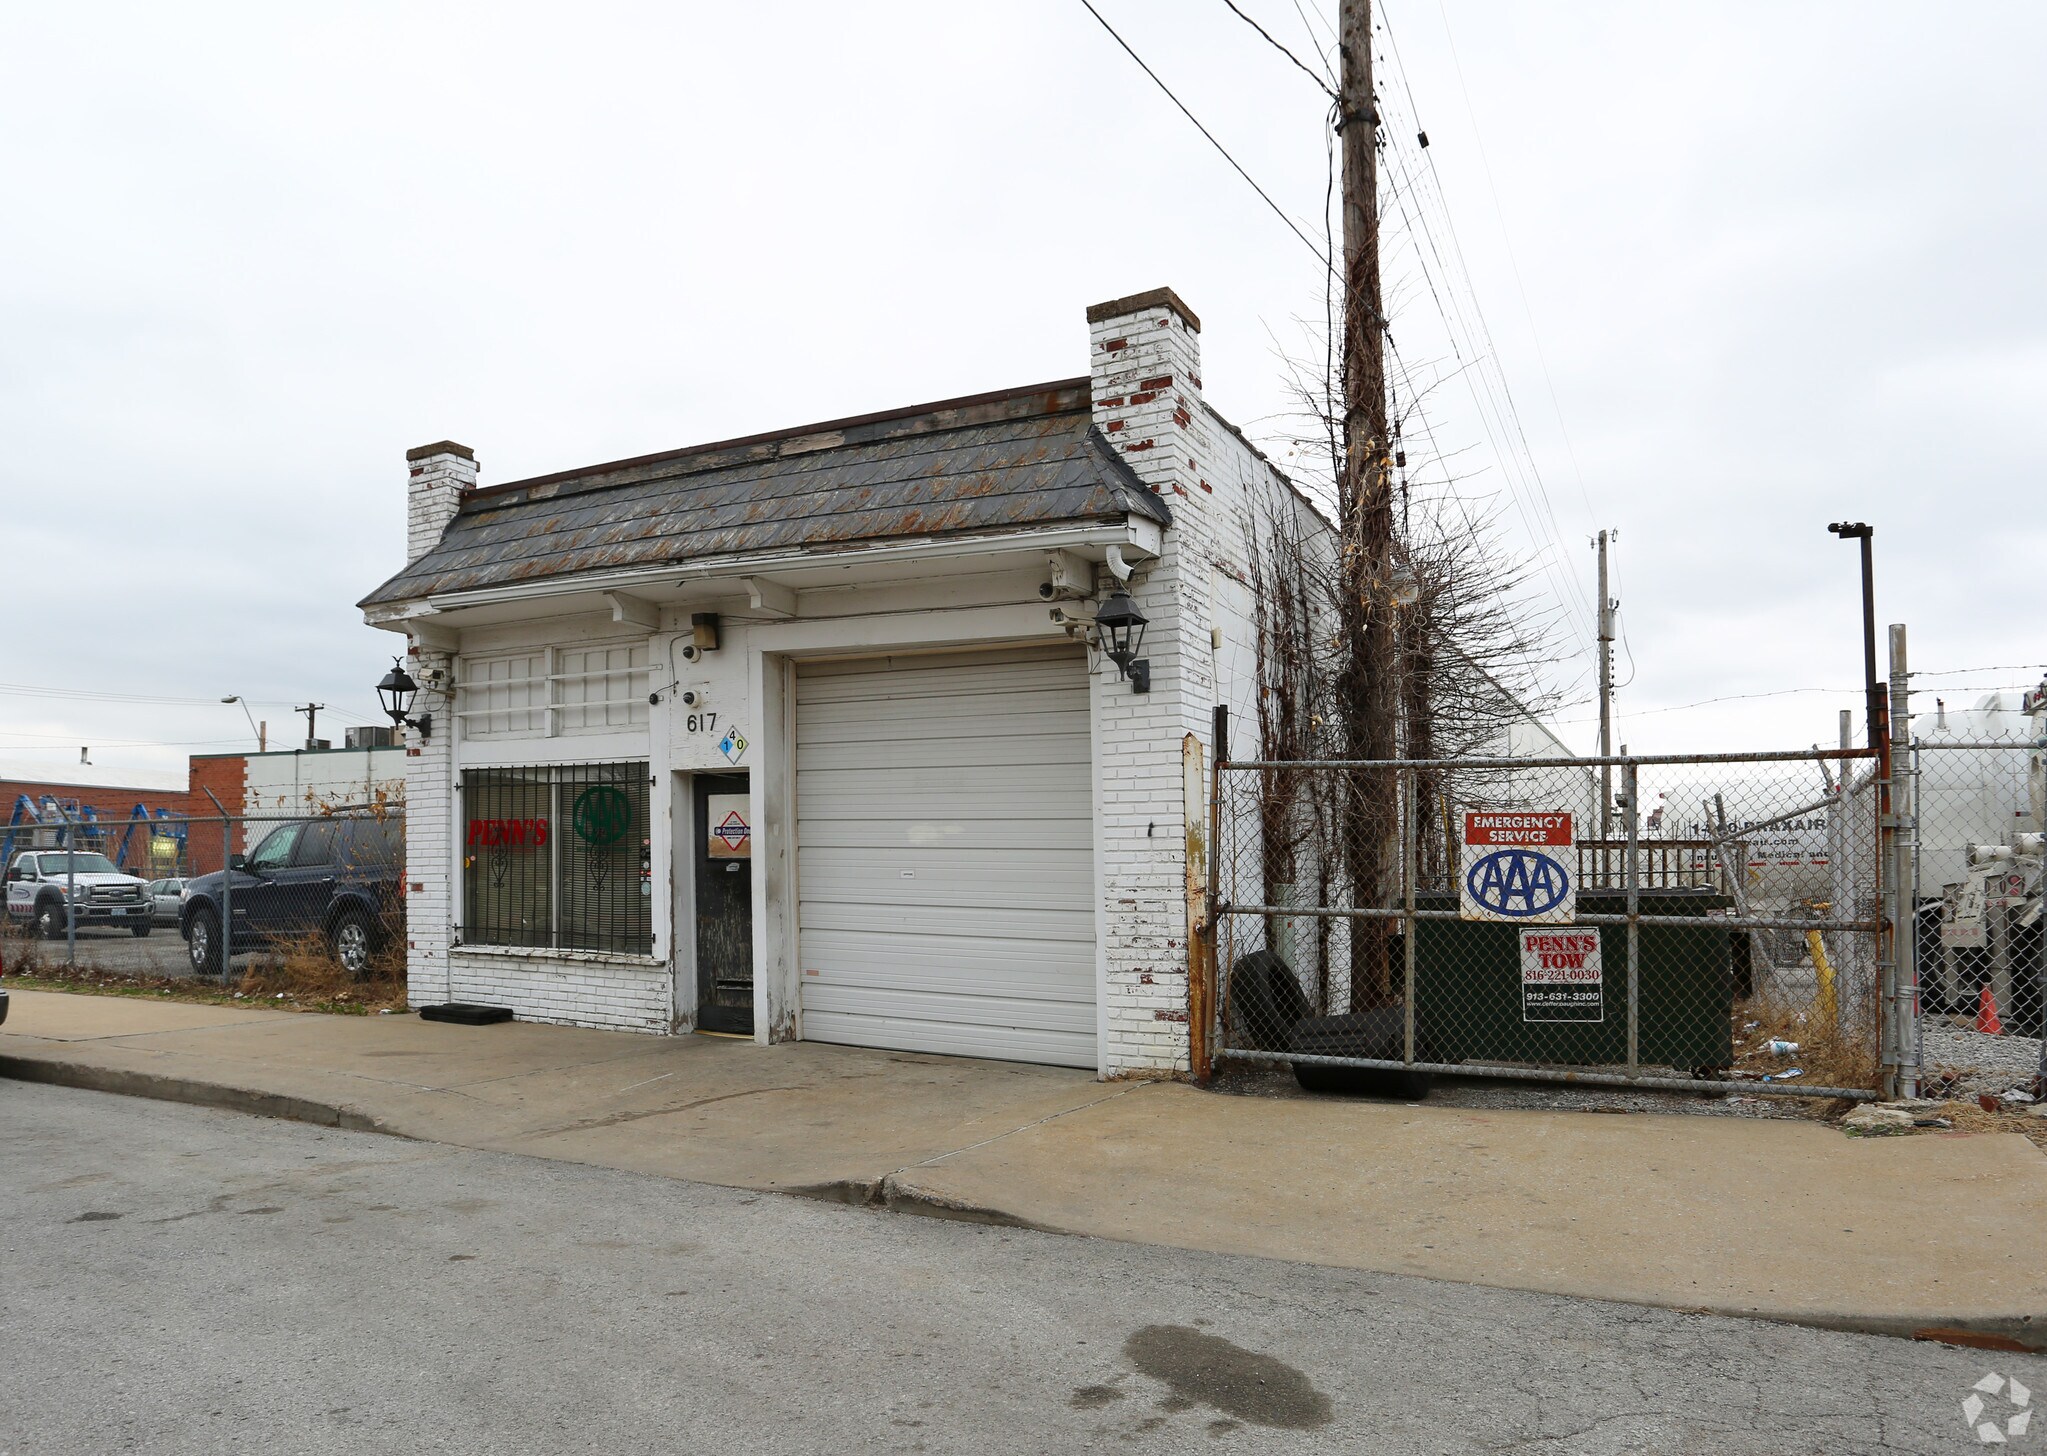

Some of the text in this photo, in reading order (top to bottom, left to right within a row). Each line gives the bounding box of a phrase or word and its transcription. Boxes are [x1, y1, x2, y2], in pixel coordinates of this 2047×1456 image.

[687, 713, 717, 732] 617
[729, 730, 736, 741] 4
[723, 741, 729, 751] 1
[736, 739, 744, 750] 0
[1473, 816, 1564, 829] EMERGENCY
[467, 819, 549, 846] PENN'S
[1489, 831, 1548, 842] SERVICE
[1480, 851, 1555, 910] AAA
[1525, 935, 1597, 952] PENN'S
[1538, 953, 1586, 969] TOW
[1526, 992, 1599, 1001] 913-631-3300
